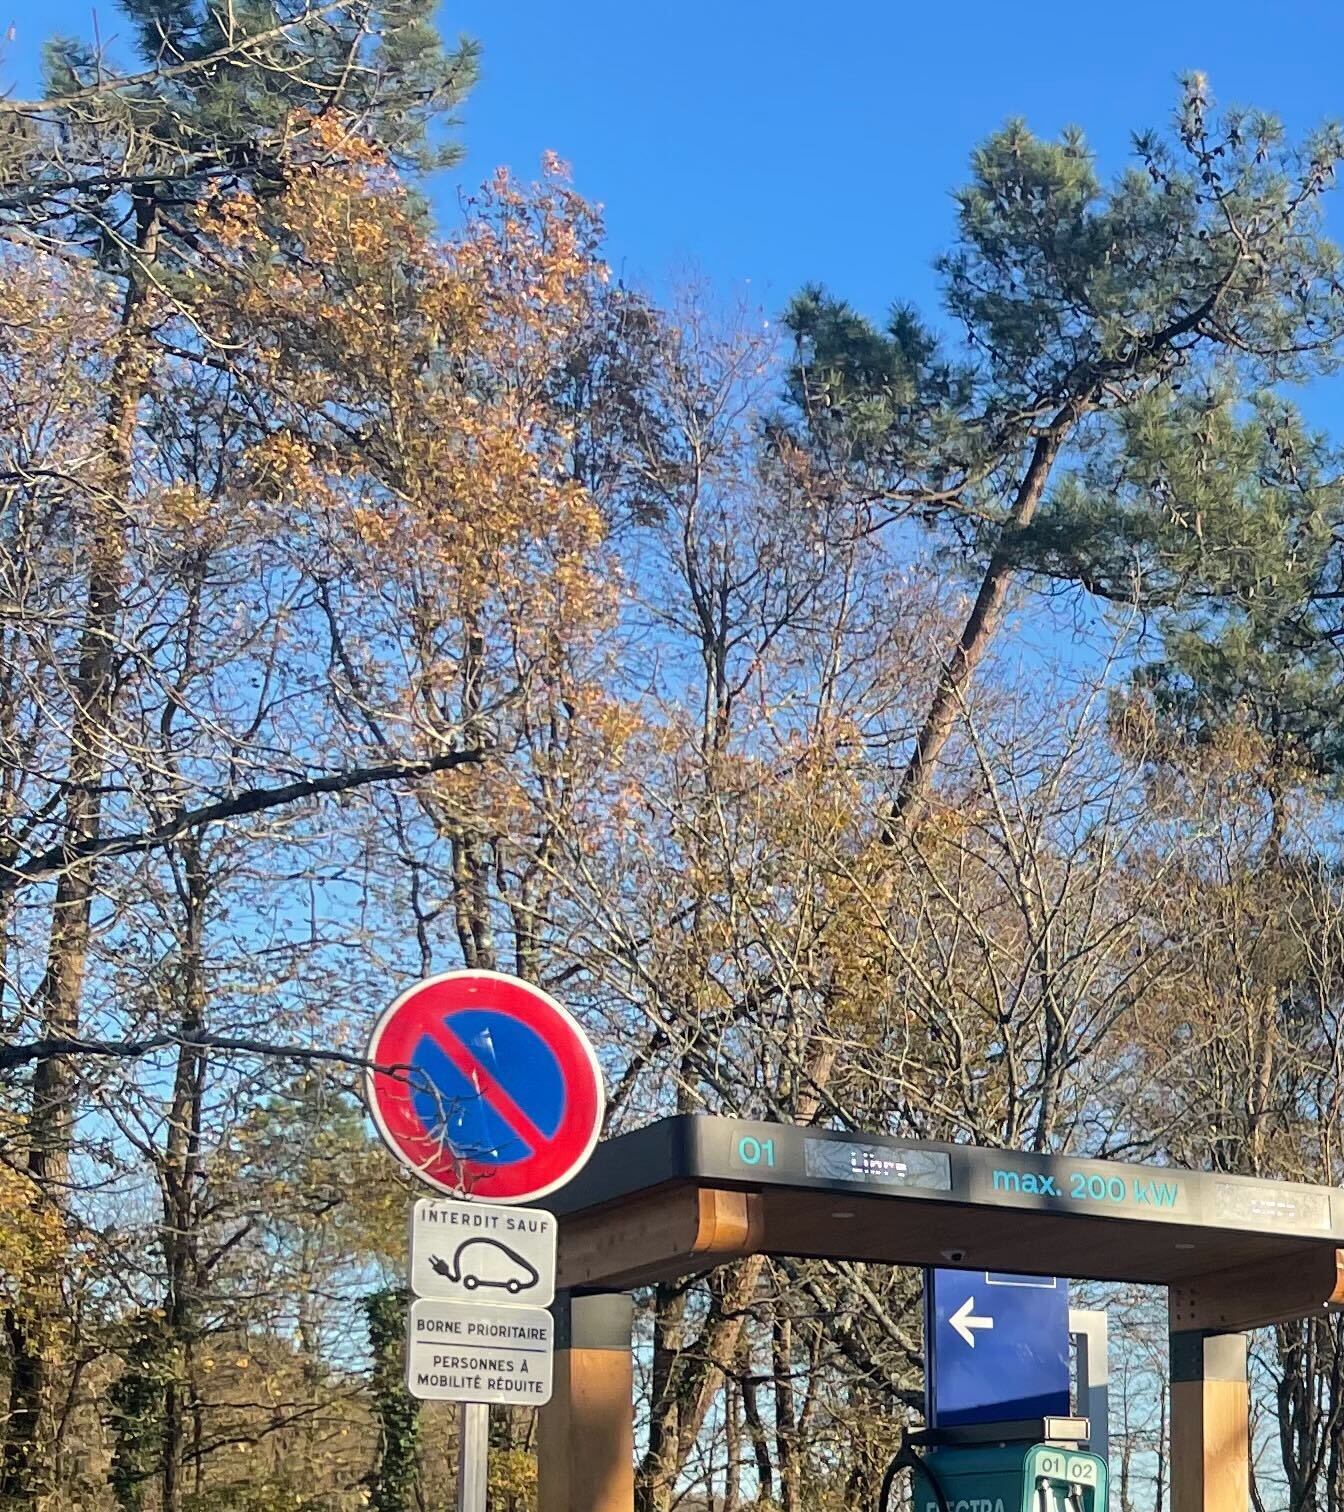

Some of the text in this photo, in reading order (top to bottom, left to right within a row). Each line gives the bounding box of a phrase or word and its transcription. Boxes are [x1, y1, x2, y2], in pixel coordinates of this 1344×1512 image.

[738, 1136, 776, 1168] 01
[992, 1168, 1179, 1208] max. 200 kW
[422, 1209, 549, 1234] INTERDIT SAUF
[416, 1319, 547, 1341] BORNE PRIORITAIRE
[433, 1355, 528, 1373] PERSONNES À
[417, 1373, 543, 1394] MOBILITÉ RÉDUITE
[1041, 1458, 1059, 1473] 01
[1071, 1464, 1093, 1478] 02
